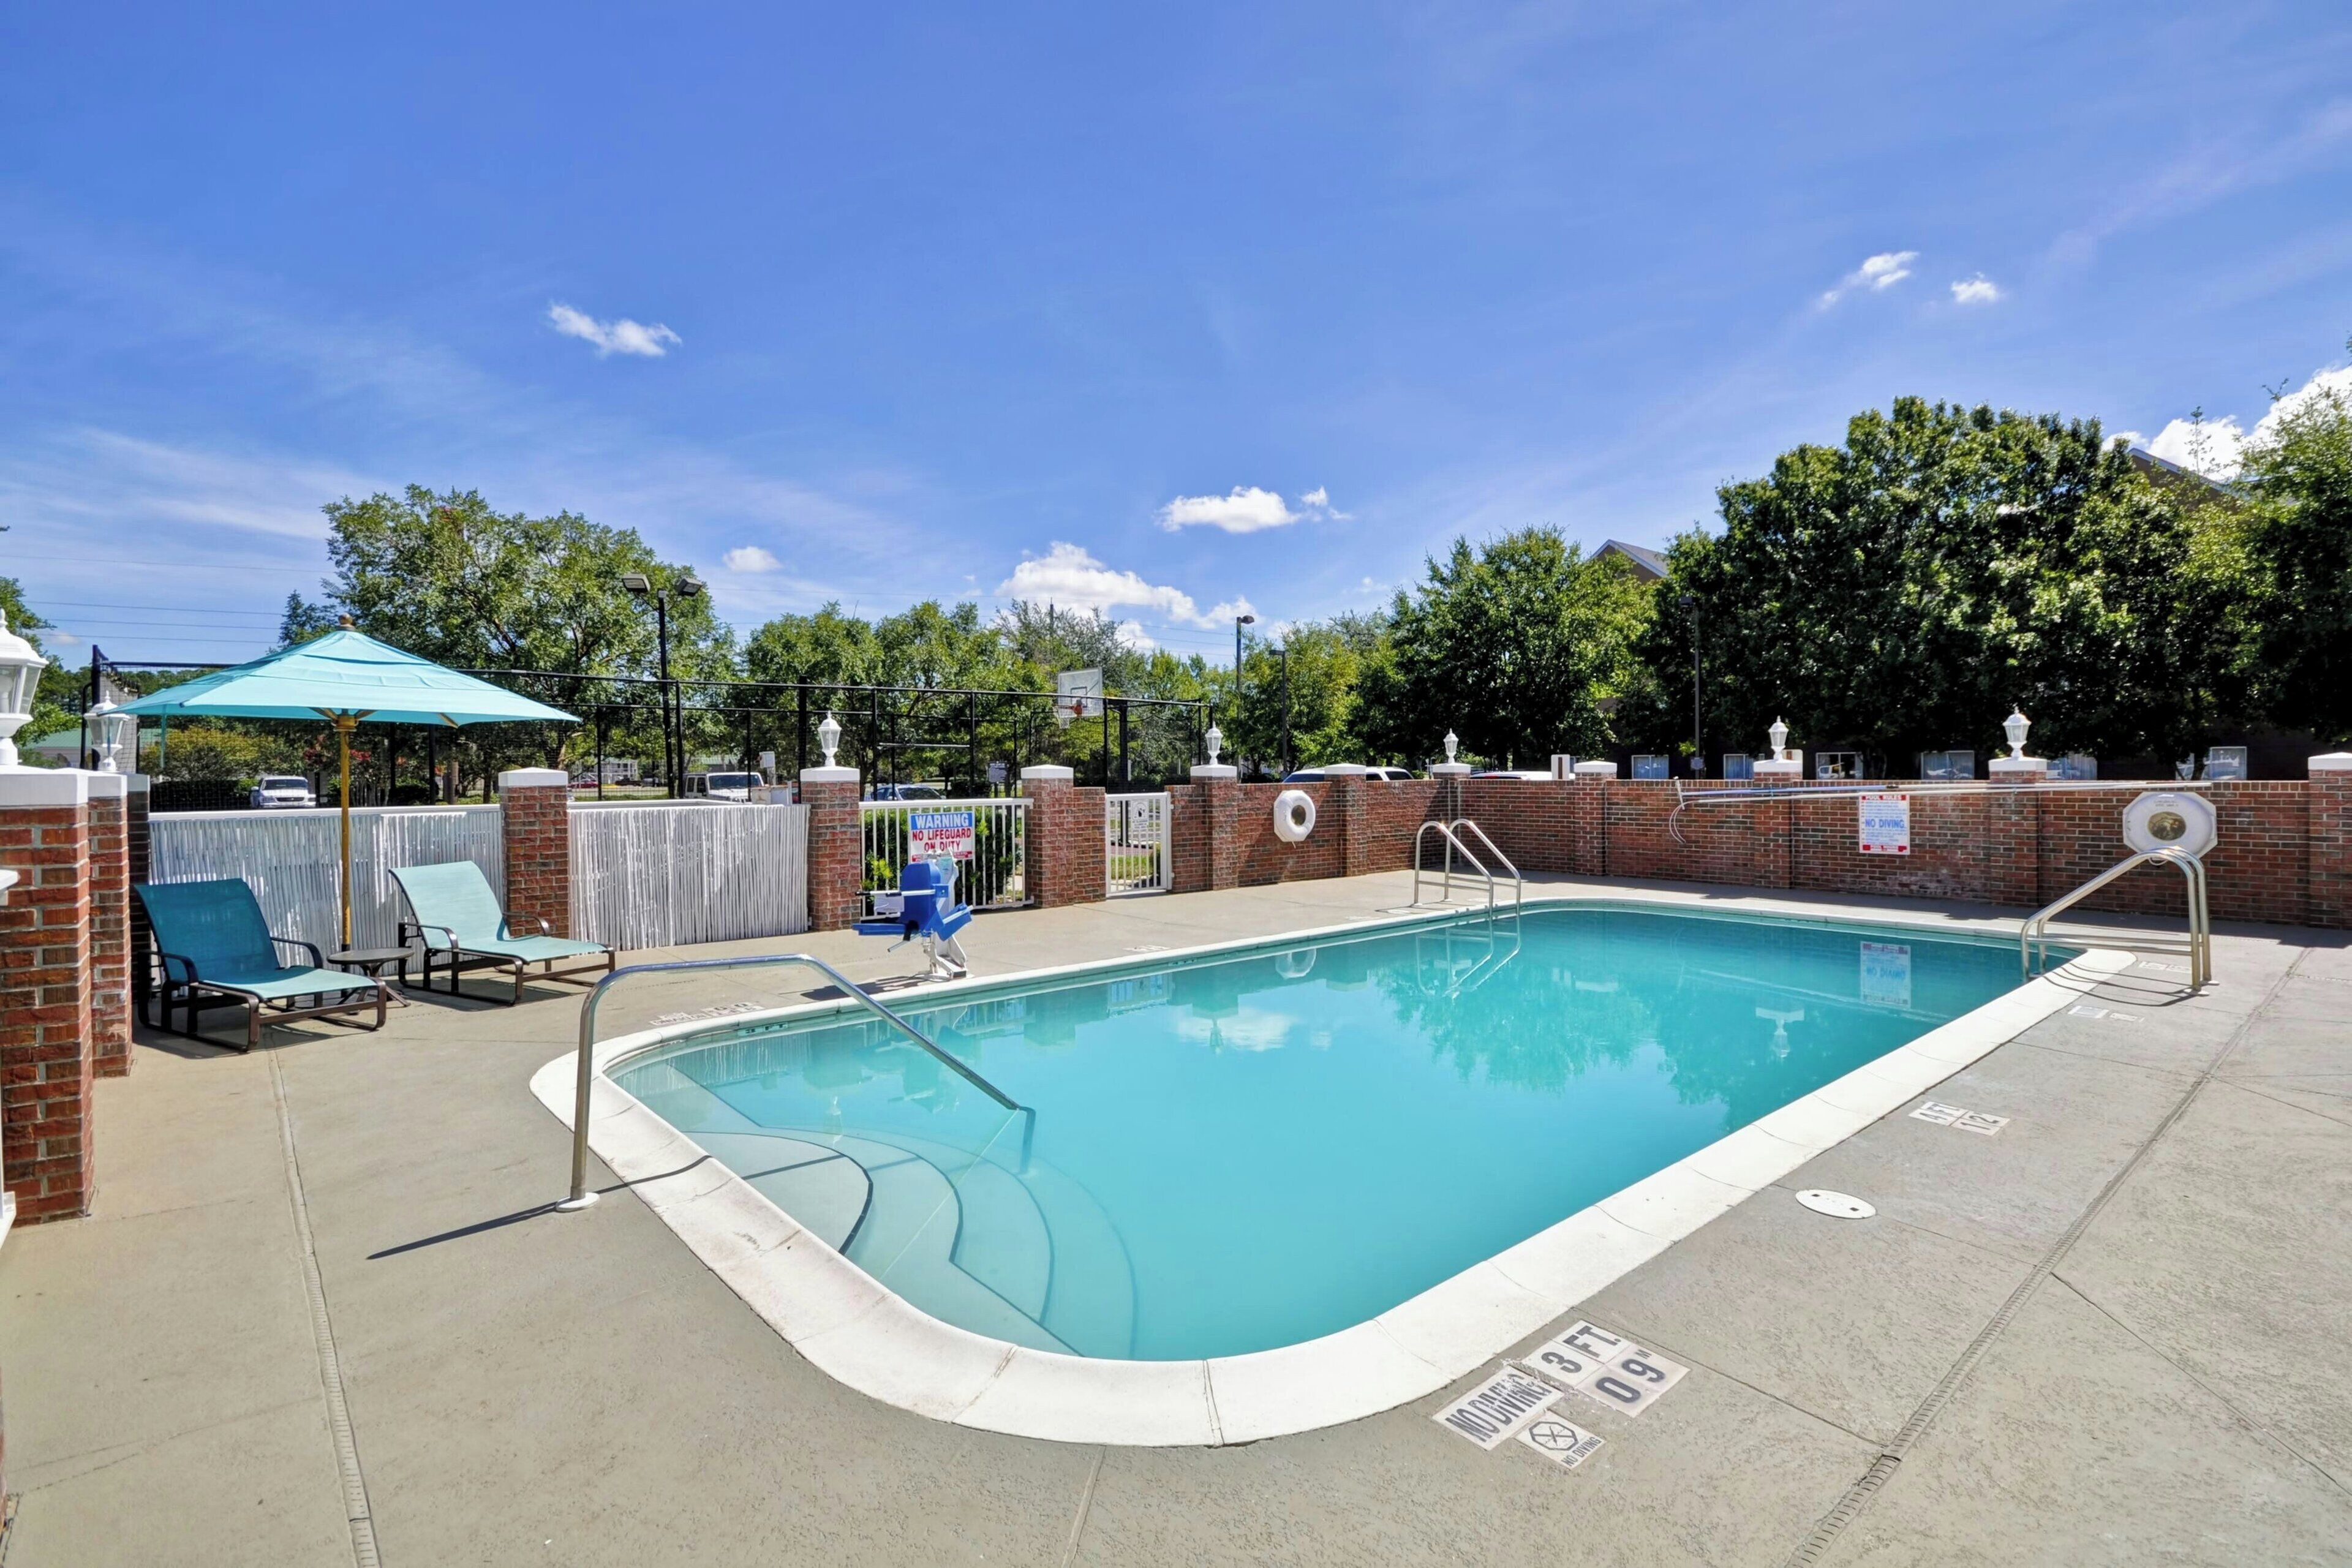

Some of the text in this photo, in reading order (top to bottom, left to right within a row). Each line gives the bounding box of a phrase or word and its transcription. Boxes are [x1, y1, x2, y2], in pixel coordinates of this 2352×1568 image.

[915, 814, 968, 829] WARNING
[1865, 819, 1875, 827] NO
[913, 828, 971, 841] NO LIFEGUARD
[924, 840, 960, 852] ON DUTY
[1541, 1351, 1582, 1374] 3
[1446, 1374, 1553, 1442] NO DIVING
[1561, 1436, 1602, 1467] NO DIVING
